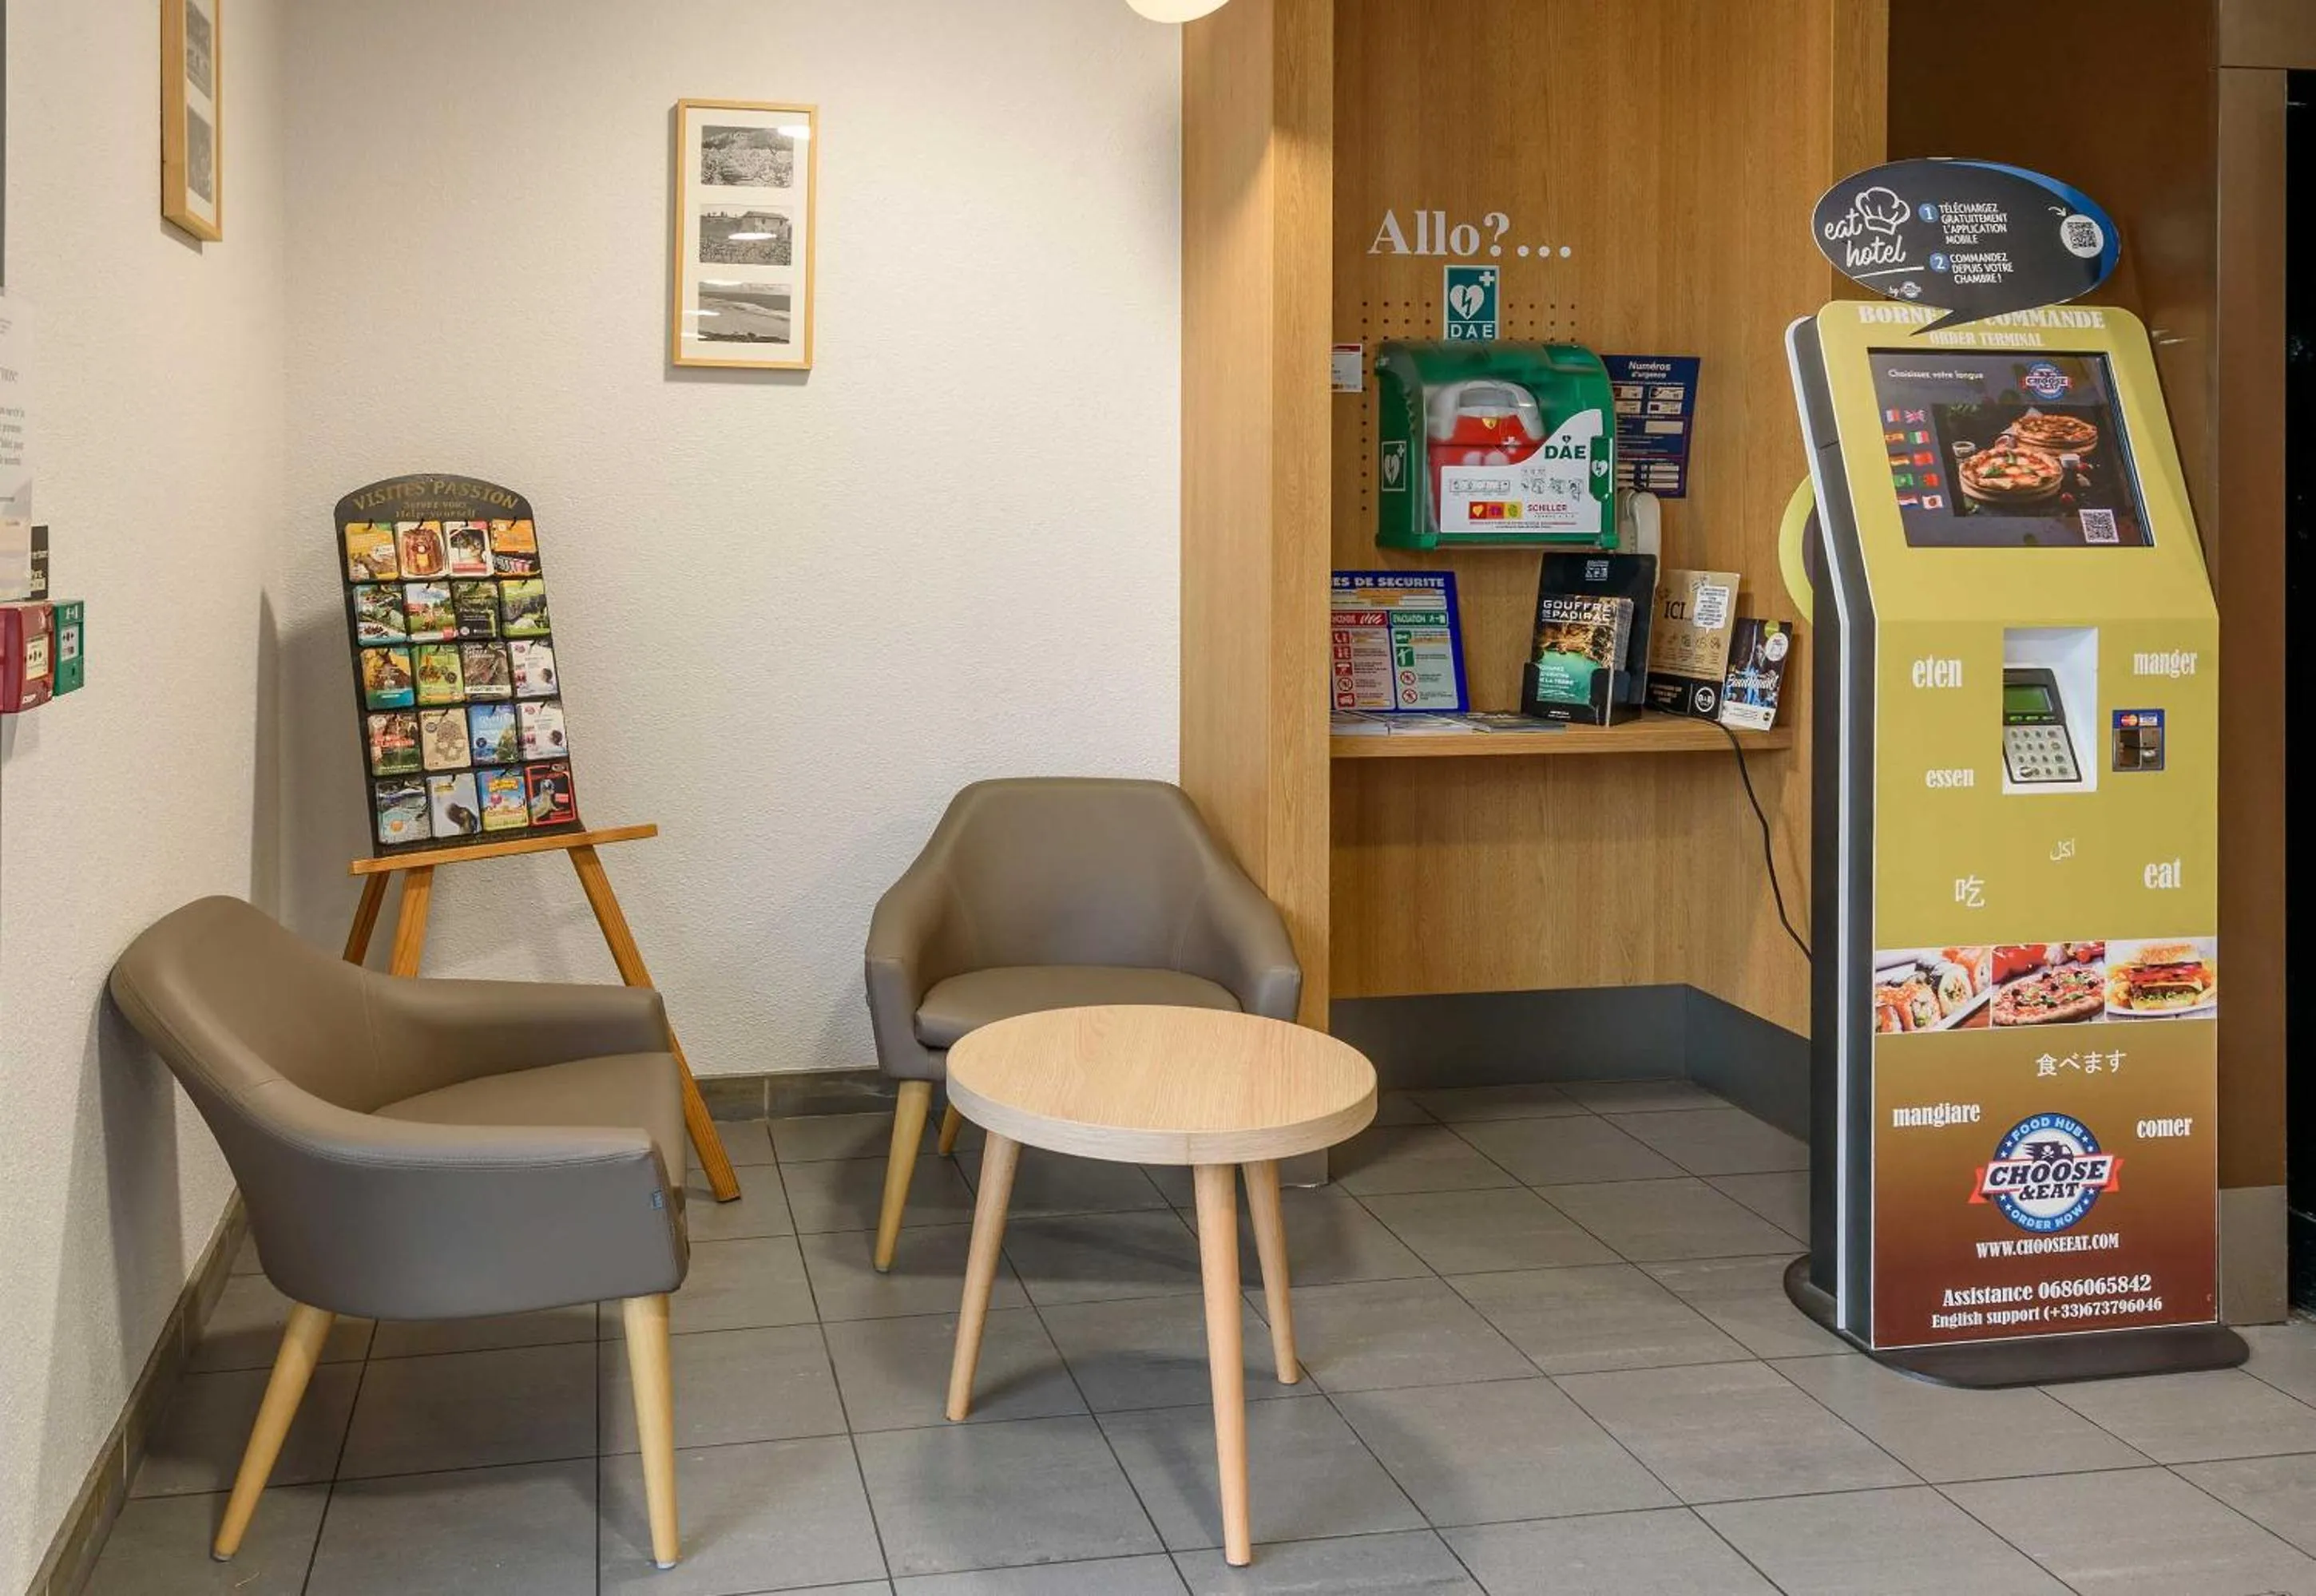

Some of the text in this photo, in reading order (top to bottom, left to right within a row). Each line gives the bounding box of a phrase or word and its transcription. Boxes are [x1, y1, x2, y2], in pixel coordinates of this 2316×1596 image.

[1938, 203, 1998, 214] TÉLÉCHARGEZ
[1941, 213, 2008, 224] GRATUITEMENT
[1825, 208, 1862, 240] eat
[1943, 224, 2008, 234] L'APPLICATION
[1946, 235, 1979, 244] MOBILE
[1845, 235, 1906, 267] hotel
[1949, 252, 2008, 263] COMMANDEZ
[1953, 262, 2014, 273] DEPUIS VOTRE
[1449, 323, 1493, 339] DAE
[1929, 331, 2045, 347] ORDER TERMINAL
[1628, 360, 1672, 371] Numéros
[1544, 445, 1587, 460] DAE
[353, 480, 519, 511] VISITES PASSION
[1527, 504, 1568, 513] SCHILLER
[1354, 576, 1374, 588] DE
[1378, 576, 1445, 588] SECURITE
[1543, 600, 1612, 612] GOUFFRE
[1664, 601, 1686, 620] ICI
[1912, 654, 1962, 687] eten
[2133, 648, 2198, 678] manger
[1925, 768, 1975, 788] essen
[2143, 857, 2182, 889] eat
[1954, 874, 1985, 907] 吃
[2035, 1048, 2128, 1077] 食べます
[1891, 1102, 1981, 1128] mangiare
[2012, 1117, 2084, 1141] FOOD HUB
[2136, 1116, 2194, 1139] comer
[1989, 1159, 2107, 1186] CHOOSE
[2018, 1182, 2081, 1202] &EAT
[2010, 1204, 2085, 1230] ORDER NOW
[1976, 1233, 2120, 1259] WWW.CHOOSEEAT.COM
[1941, 1274, 2152, 1307] Assistance 0686065842
[1931, 1297, 2163, 1329] English support (+33)673796046
